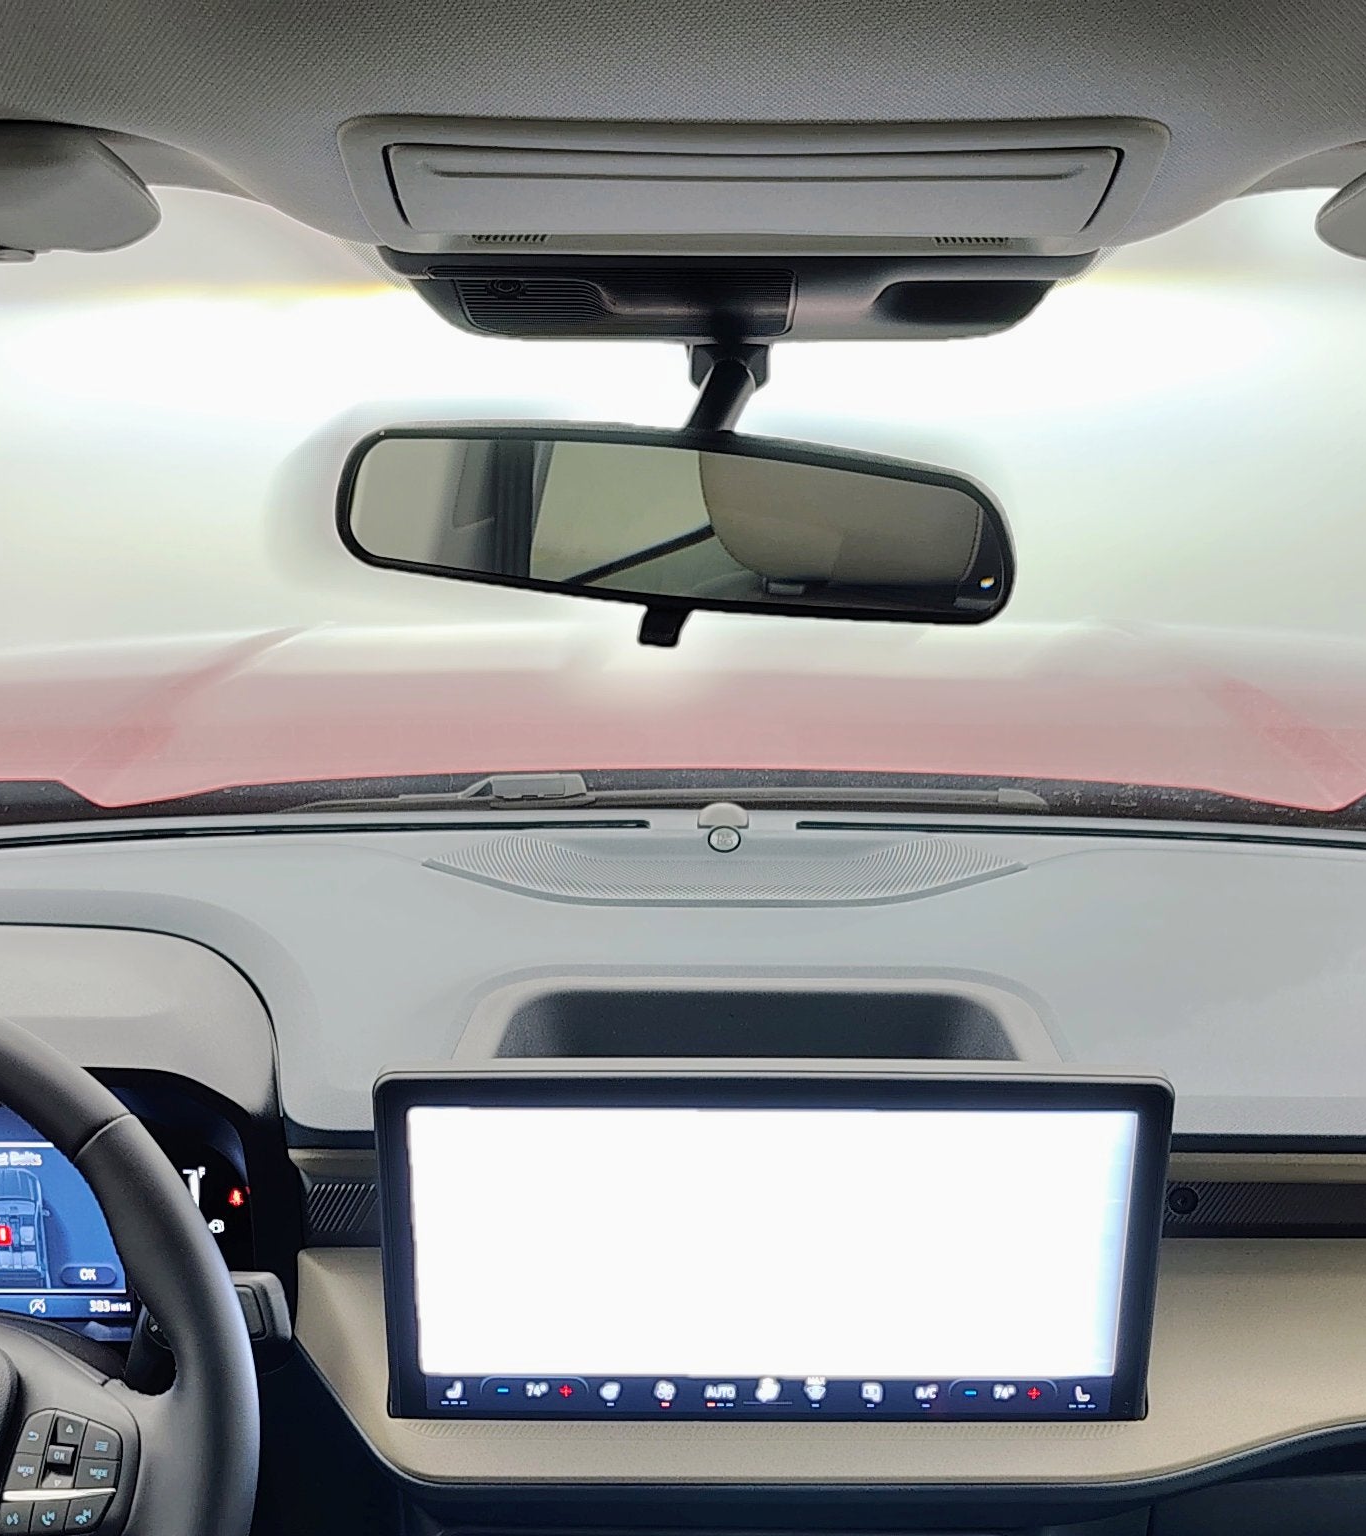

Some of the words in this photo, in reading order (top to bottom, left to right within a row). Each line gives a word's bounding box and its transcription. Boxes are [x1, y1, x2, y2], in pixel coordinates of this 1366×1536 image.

[80, 1268, 97, 1281] OK
[705, 1385, 736, 1399] AUTO
[915, 1385, 938, 1399] A/C
[53, 1451, 65, 1461] OK
